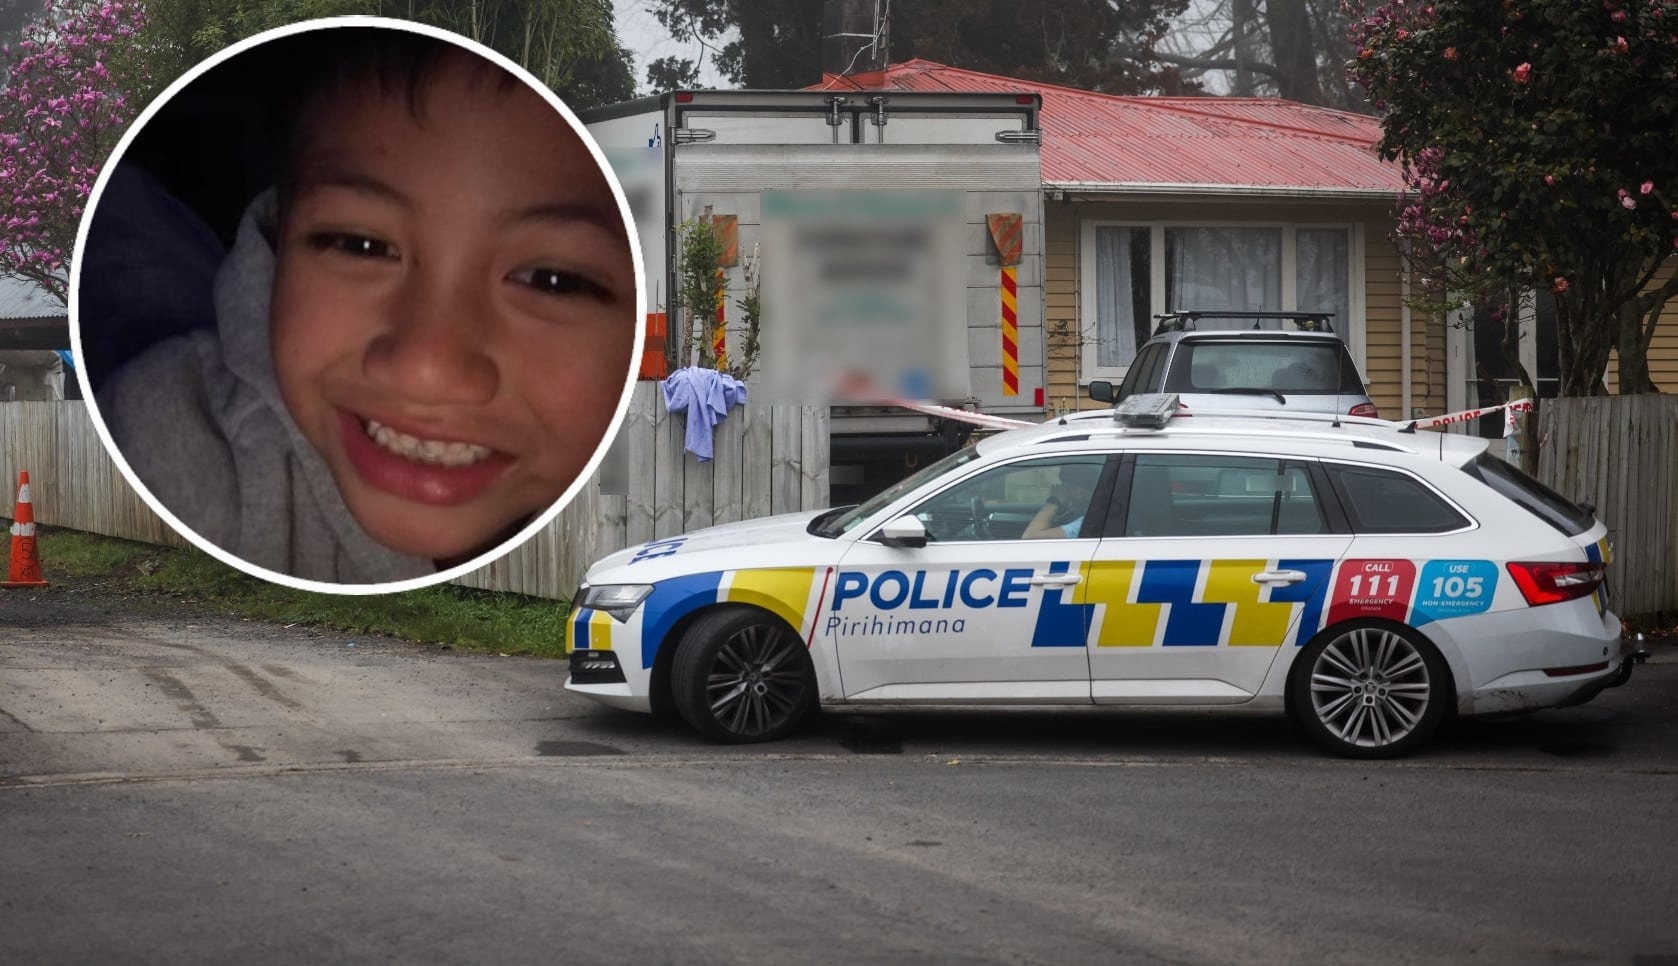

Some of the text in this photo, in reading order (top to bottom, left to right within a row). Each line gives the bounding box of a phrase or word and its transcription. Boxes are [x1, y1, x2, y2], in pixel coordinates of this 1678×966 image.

[1365, 563, 1390, 572] CALL
[1449, 564, 1470, 573] USE
[831, 568, 1035, 611] POLICE
[1350, 575, 1400, 596] 111
[1432, 576, 1484, 598] 105
[825, 614, 966, 637] Pirihimana
